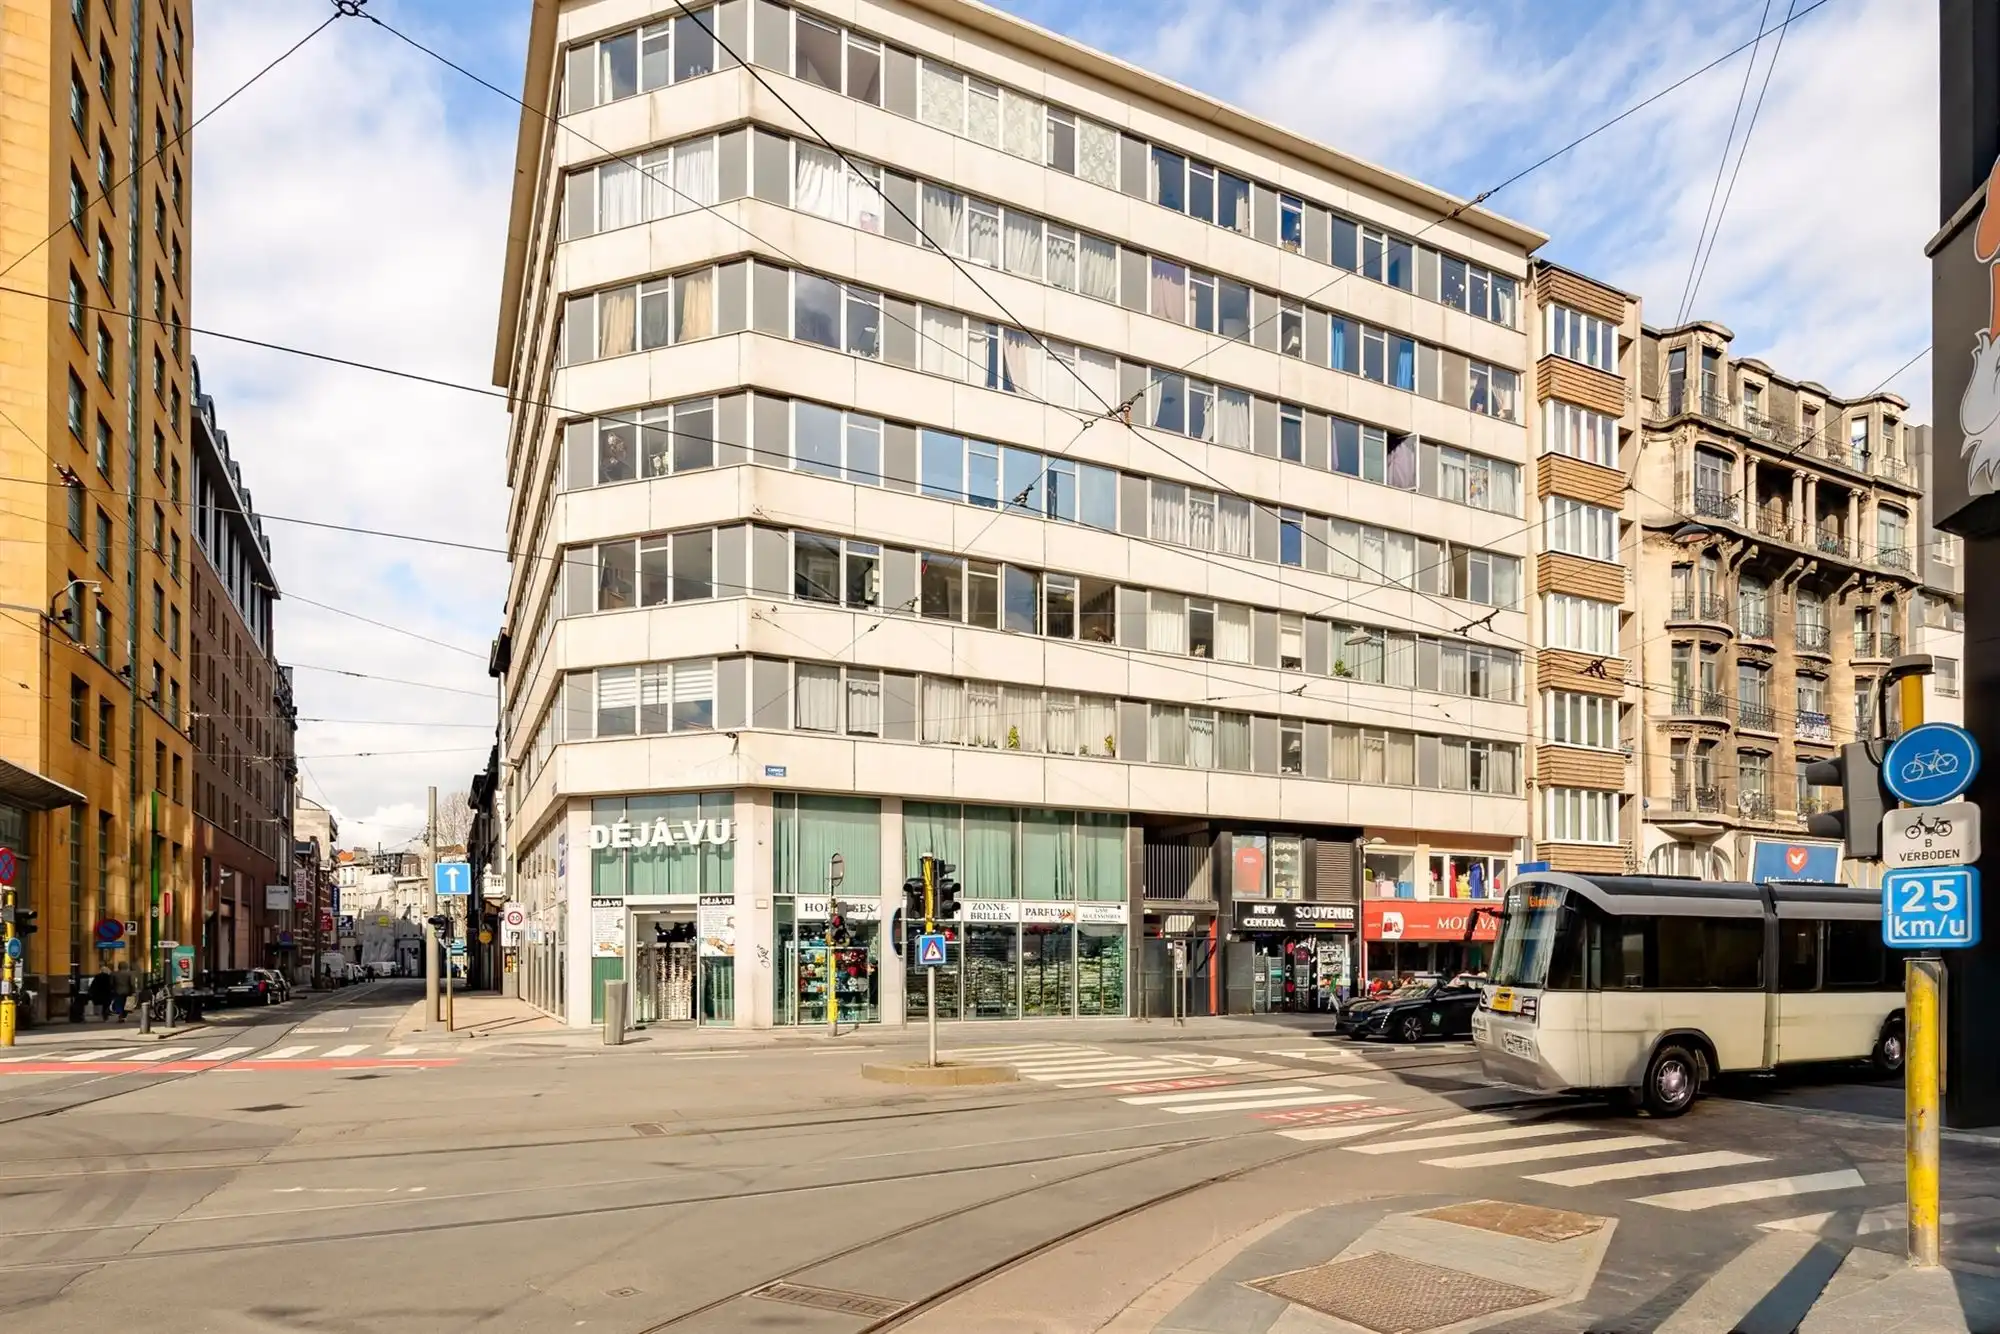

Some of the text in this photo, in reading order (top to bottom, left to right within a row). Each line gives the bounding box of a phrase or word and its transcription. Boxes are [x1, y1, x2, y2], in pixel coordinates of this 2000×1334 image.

[1924, 838, 1933, 847] B
[1899, 849, 1960, 861] VERBODEN
[1901, 879, 1958, 912] 25
[972, 903, 1010, 911] ZONNE-
[1253, 905, 1277, 914] NEW
[970, 912, 1011, 920] BRILLEN
[1025, 907, 1071, 917] PARFUMS
[1295, 906, 1354, 919] SOUVENIR
[1243, 918, 1286, 927] CENTRAL
[1894, 914, 1966, 937] km/u
